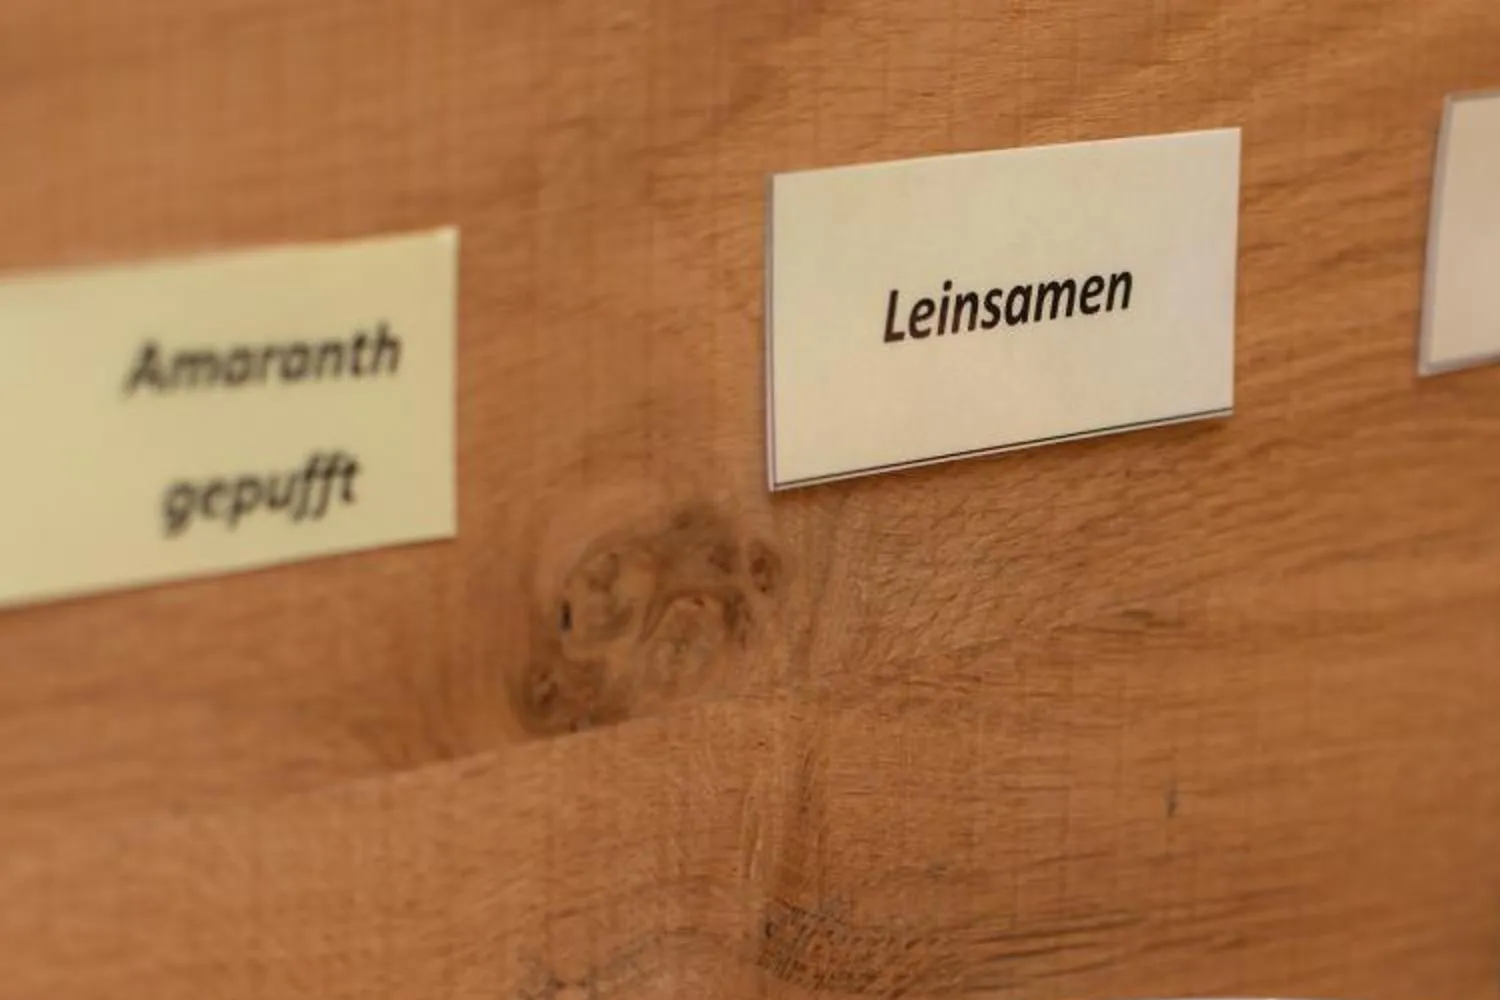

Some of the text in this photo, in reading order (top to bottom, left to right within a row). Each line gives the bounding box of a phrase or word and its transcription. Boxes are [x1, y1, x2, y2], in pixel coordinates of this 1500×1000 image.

[883, 270, 1133, 344] Leinsamen
[125, 322, 402, 393] Amaranth
[163, 450, 360, 537] gepufft
